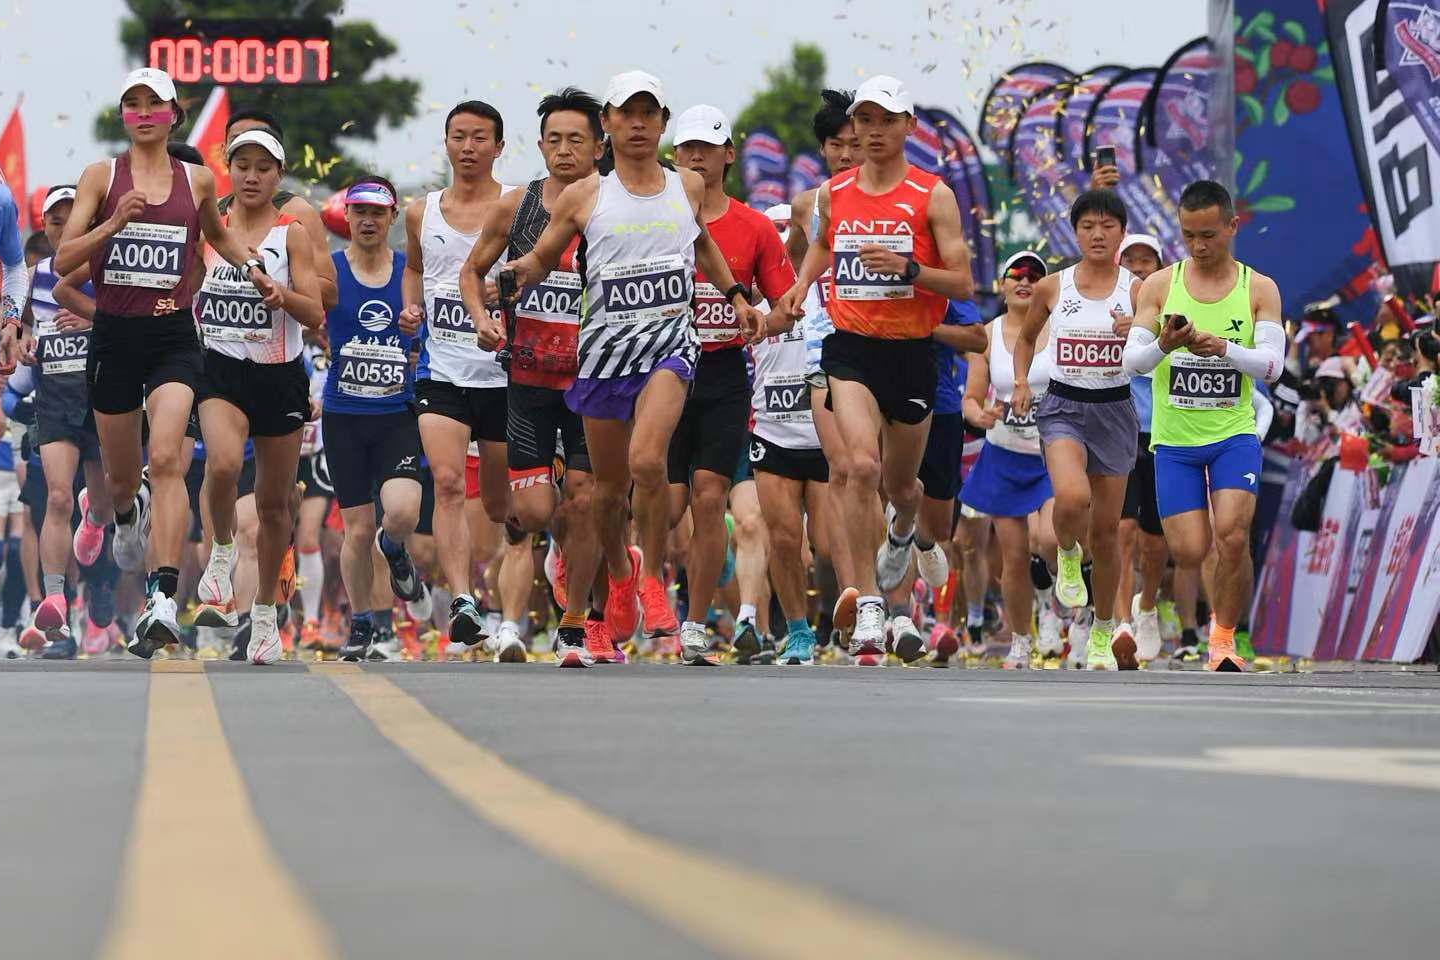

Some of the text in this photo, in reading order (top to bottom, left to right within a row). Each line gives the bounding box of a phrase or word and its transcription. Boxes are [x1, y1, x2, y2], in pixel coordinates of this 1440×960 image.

[150, 38, 330, 84] 00:00:07
[835, 220, 914, 235] ANTA
[107, 243, 179, 271] A0001
[608, 275, 683, 307] A0010
[201, 298, 268, 325] A0006
[696, 302, 736, 325] 289
[43, 336, 89, 358] A052
[1060, 342, 1122, 363] B0640
[341, 360, 405, 384] A0535
[1172, 372, 1237, 394] A0631
